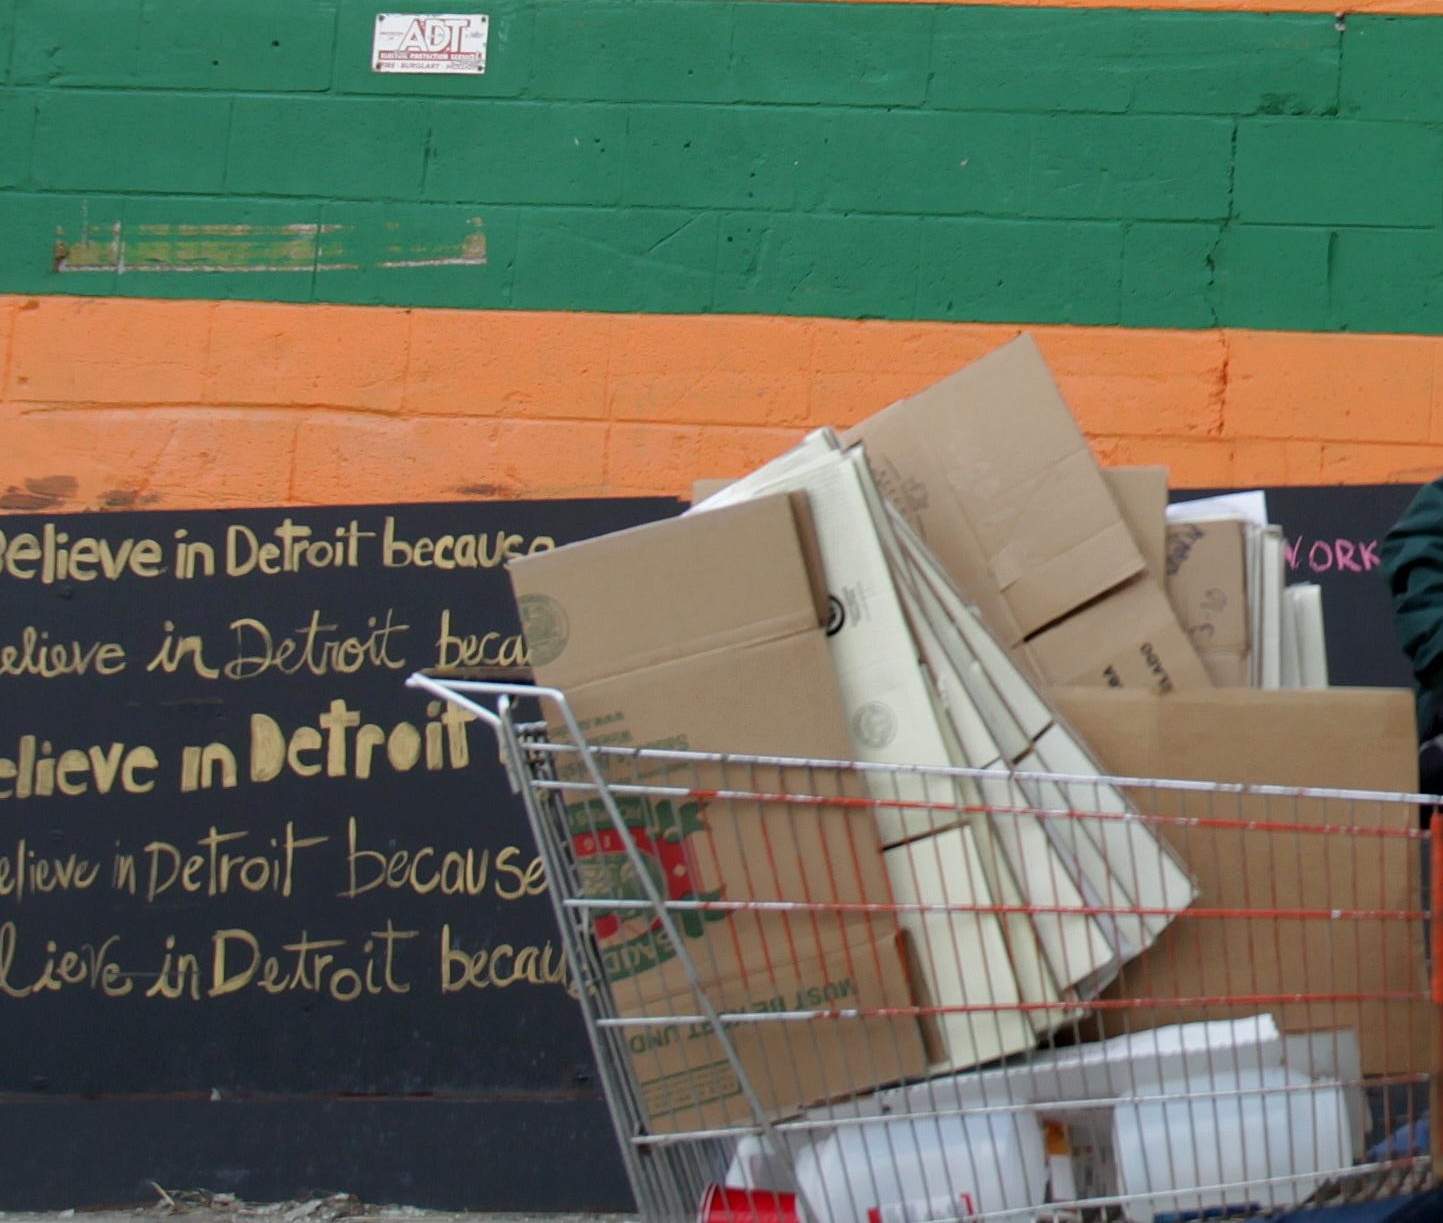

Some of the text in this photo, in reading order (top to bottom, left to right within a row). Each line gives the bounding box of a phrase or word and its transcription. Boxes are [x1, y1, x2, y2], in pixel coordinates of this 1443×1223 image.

[398, 18, 471, 52] ADT
[174, 528, 215, 578] in
[226, 517, 377, 576] Detroit
[147, 620, 219, 679] in
[224, 608, 411, 680] Detroit
[436, 609, 534, 668] beca
[181, 741, 238, 792] in
[250, 698, 480, 782] Detroit
[112, 840, 137, 895] in
[143, 816, 329, 902] Detroit
[337, 816, 548, 901] because
[146, 936, 199, 1001] in
[208, 919, 419, 1002] Detroit
[795, 977, 859, 1010] MUST
